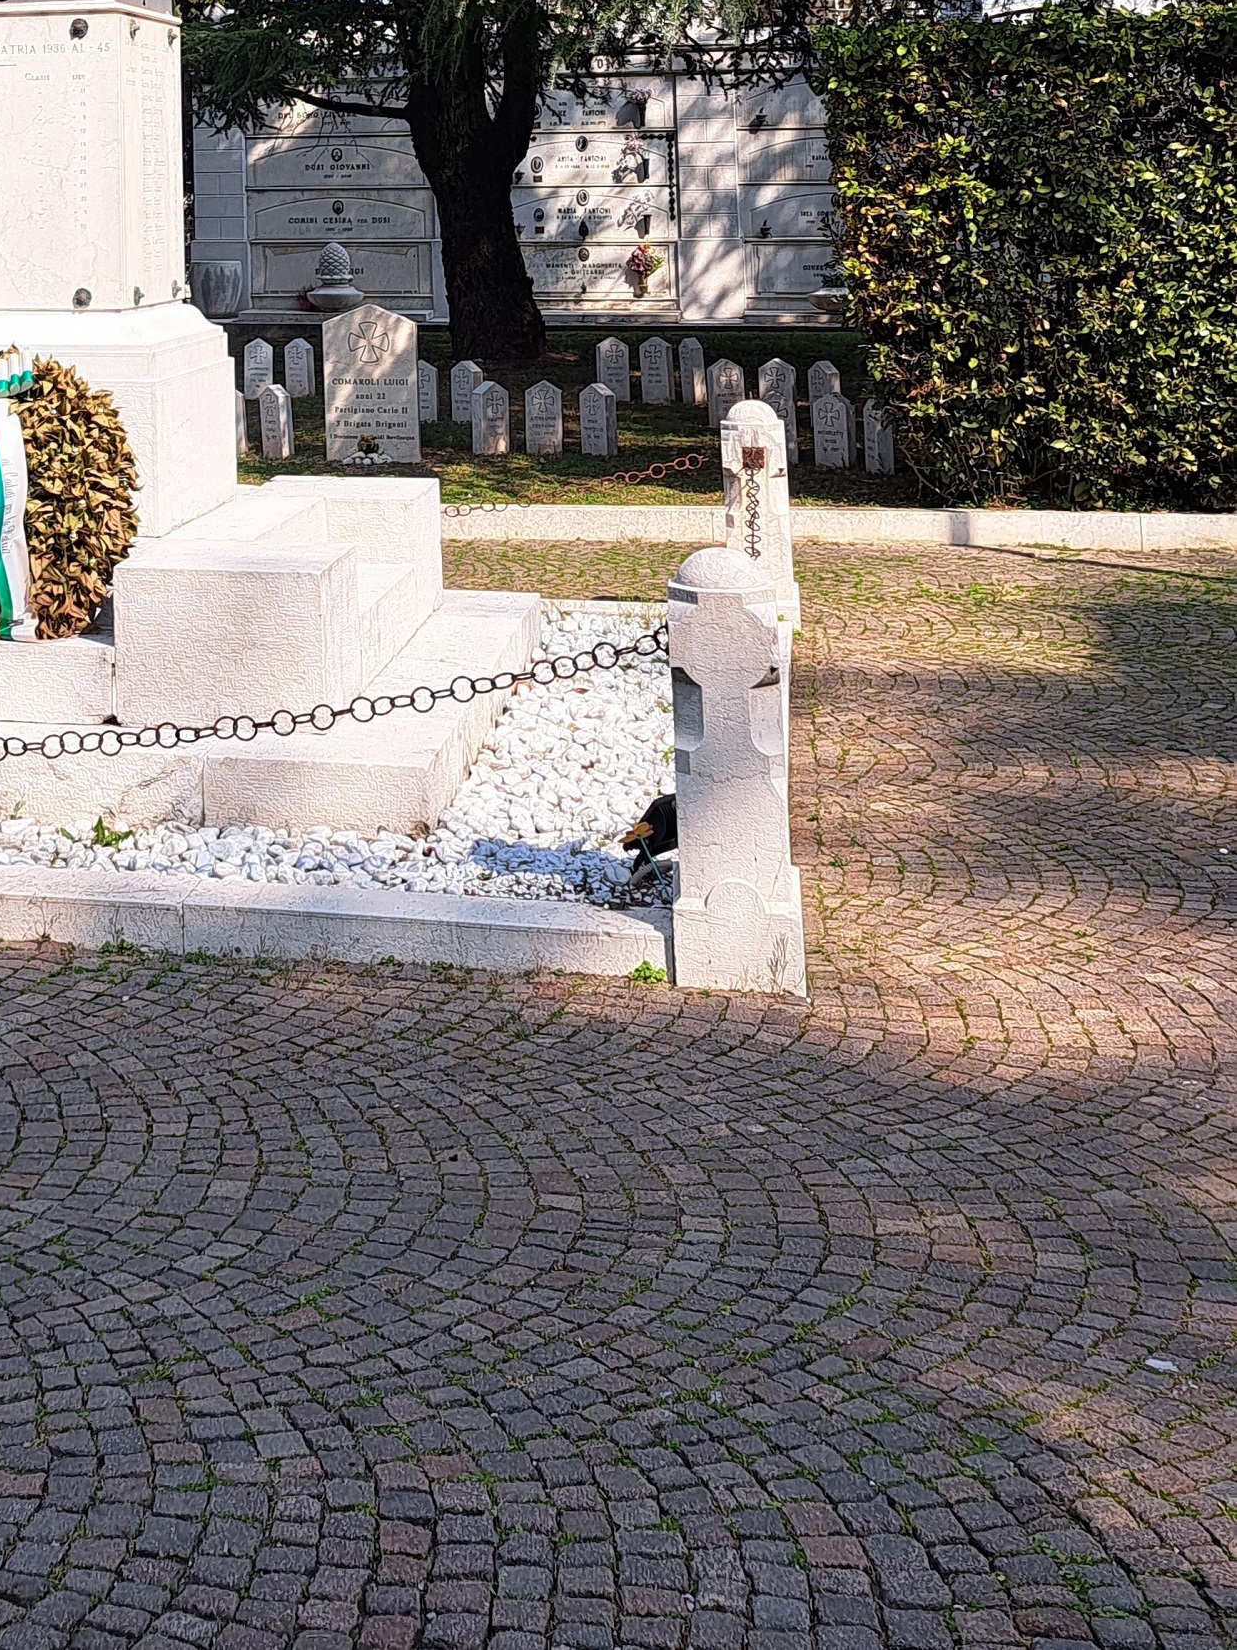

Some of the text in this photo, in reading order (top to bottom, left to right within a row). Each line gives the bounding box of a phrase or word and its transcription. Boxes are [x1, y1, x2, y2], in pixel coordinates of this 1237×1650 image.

[71, 43, 86, 53] AL
[331, 378, 409, 386] COMAROLI LUIGI
[334, 406, 375, 415] Partigiano
[377, 406, 399, 414] Carlo
[344, 420, 372, 429] Brigata
[3, 472, 19, 499] Caduti
[1, 525, 16, 554] Patria
